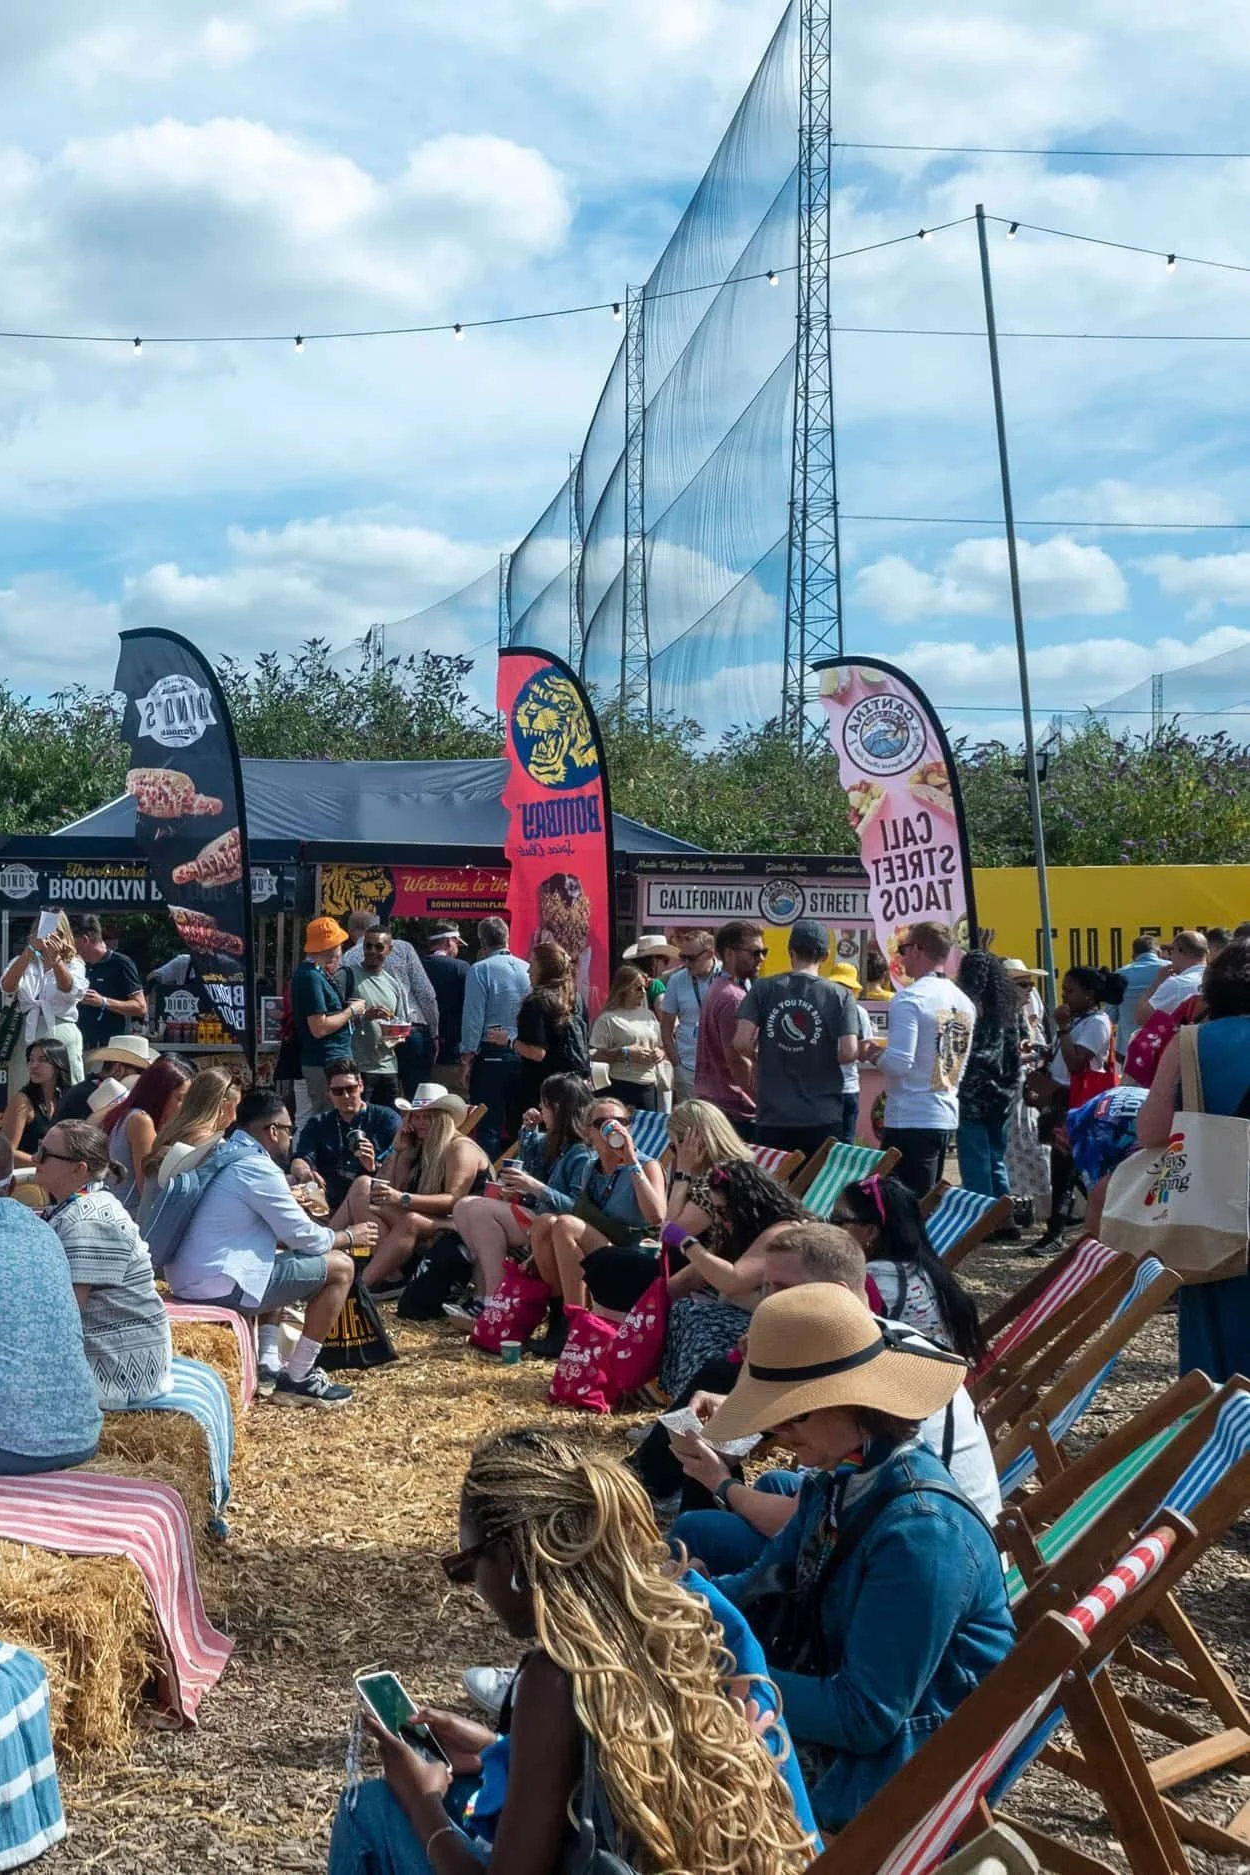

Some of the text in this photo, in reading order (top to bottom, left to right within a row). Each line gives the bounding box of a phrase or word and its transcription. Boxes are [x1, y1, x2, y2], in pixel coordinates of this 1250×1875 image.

[49, 878, 146, 900] BROOKLYN
[401, 875, 468, 892] Welcome
[473, 877, 486, 892] to
[659, 889, 751, 911] CALIFORNIAN
[810, 893, 857, 914] STREET
